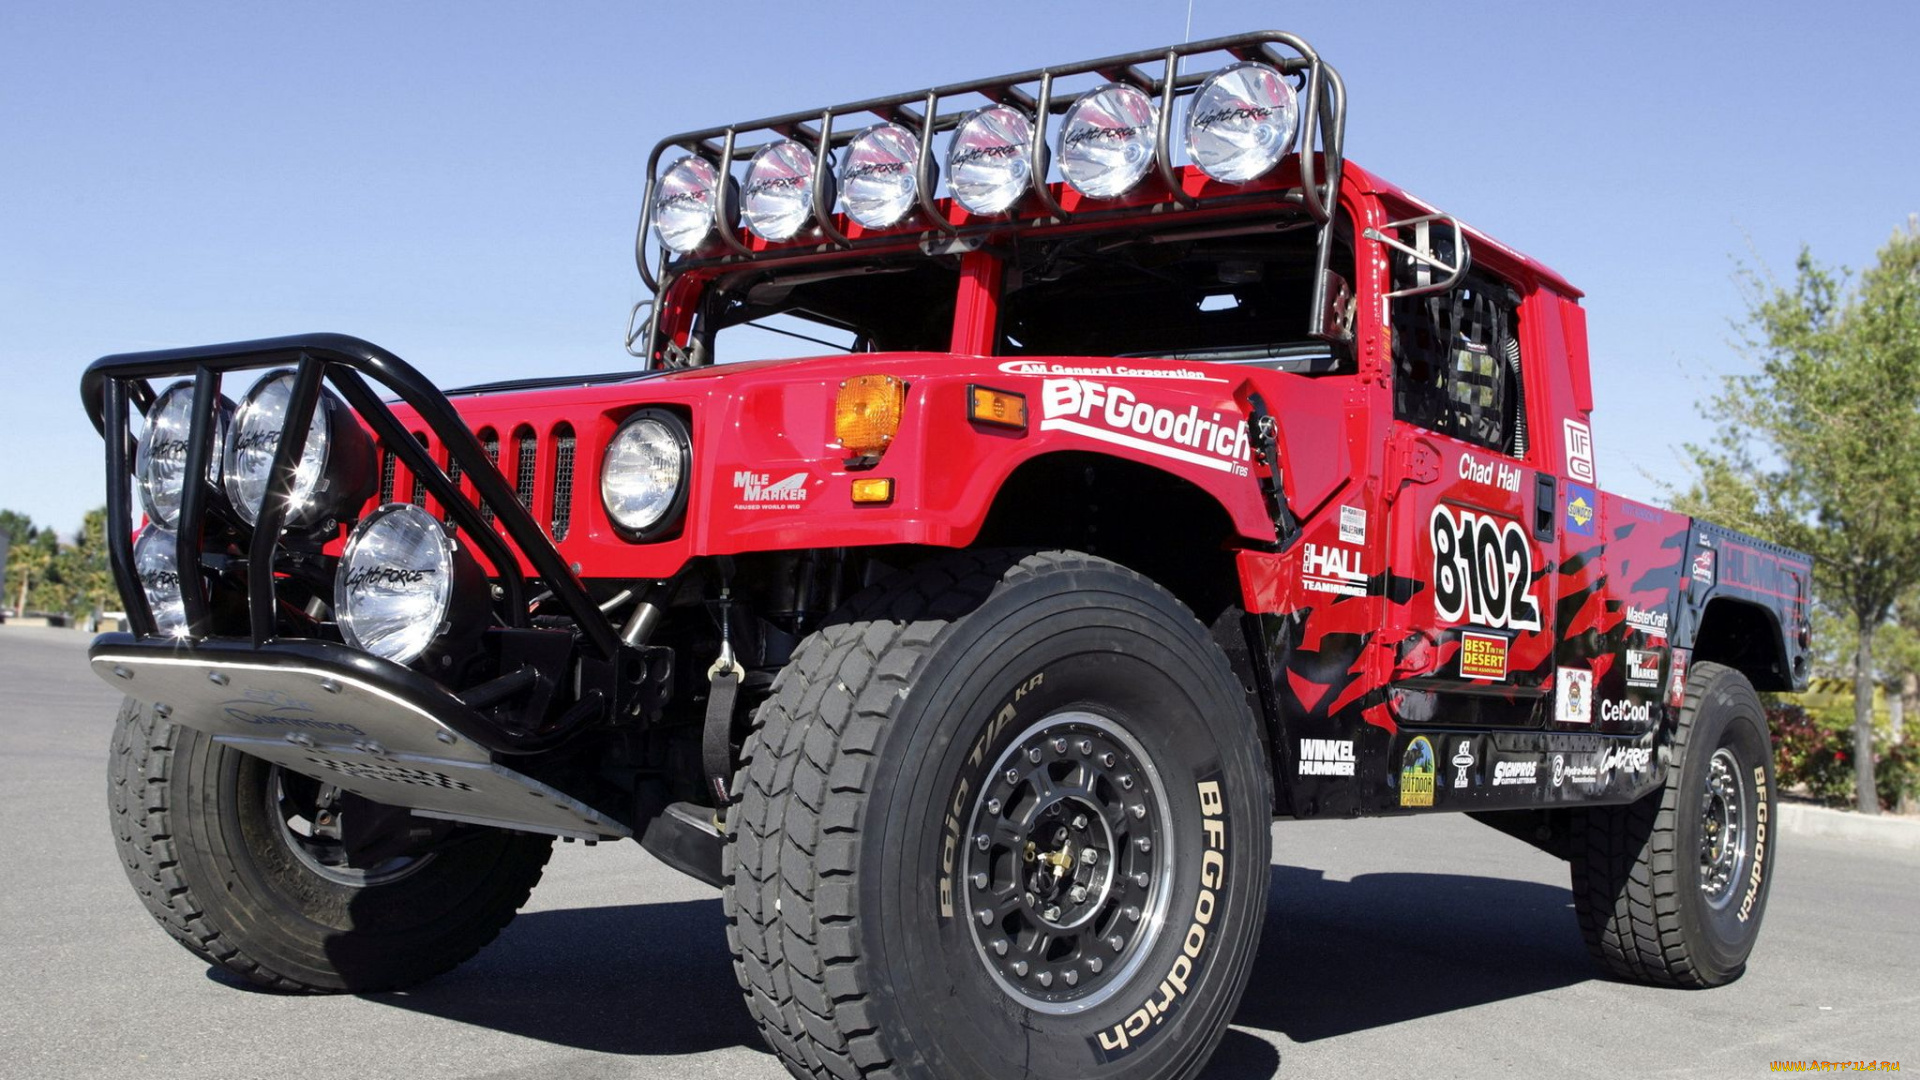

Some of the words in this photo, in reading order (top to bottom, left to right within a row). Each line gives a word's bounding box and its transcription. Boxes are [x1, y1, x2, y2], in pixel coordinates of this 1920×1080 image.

[1051, 364, 1112, 375] General
[1116, 365, 1205, 378] Corporation
[1041, 377, 1250, 462] BFGoodrich
[1459, 452, 1494, 486] Chad
[1496, 462, 1522, 492] Hall
[743, 485, 807, 501] MARKER
[1308, 543, 1368, 582] HALL
[1430, 503, 1541, 632] 8102
[343, 566, 436, 595] LightFORCE
[1626, 605, 1669, 628] MasterCraft
[1464, 639, 1492, 653] BEST
[1463, 652, 1505, 667] DESERT
[1601, 698, 1650, 722] CelCool
[1300, 738, 1356, 762] WINKEL
[1298, 760, 1355, 776] HUMMER
[938, 777, 969, 918] Baja
[1014, 671, 1046, 703] KR
[1737, 766, 1768, 923] BFGoodrich
[1098, 779, 1225, 1050] BFGoodrich
